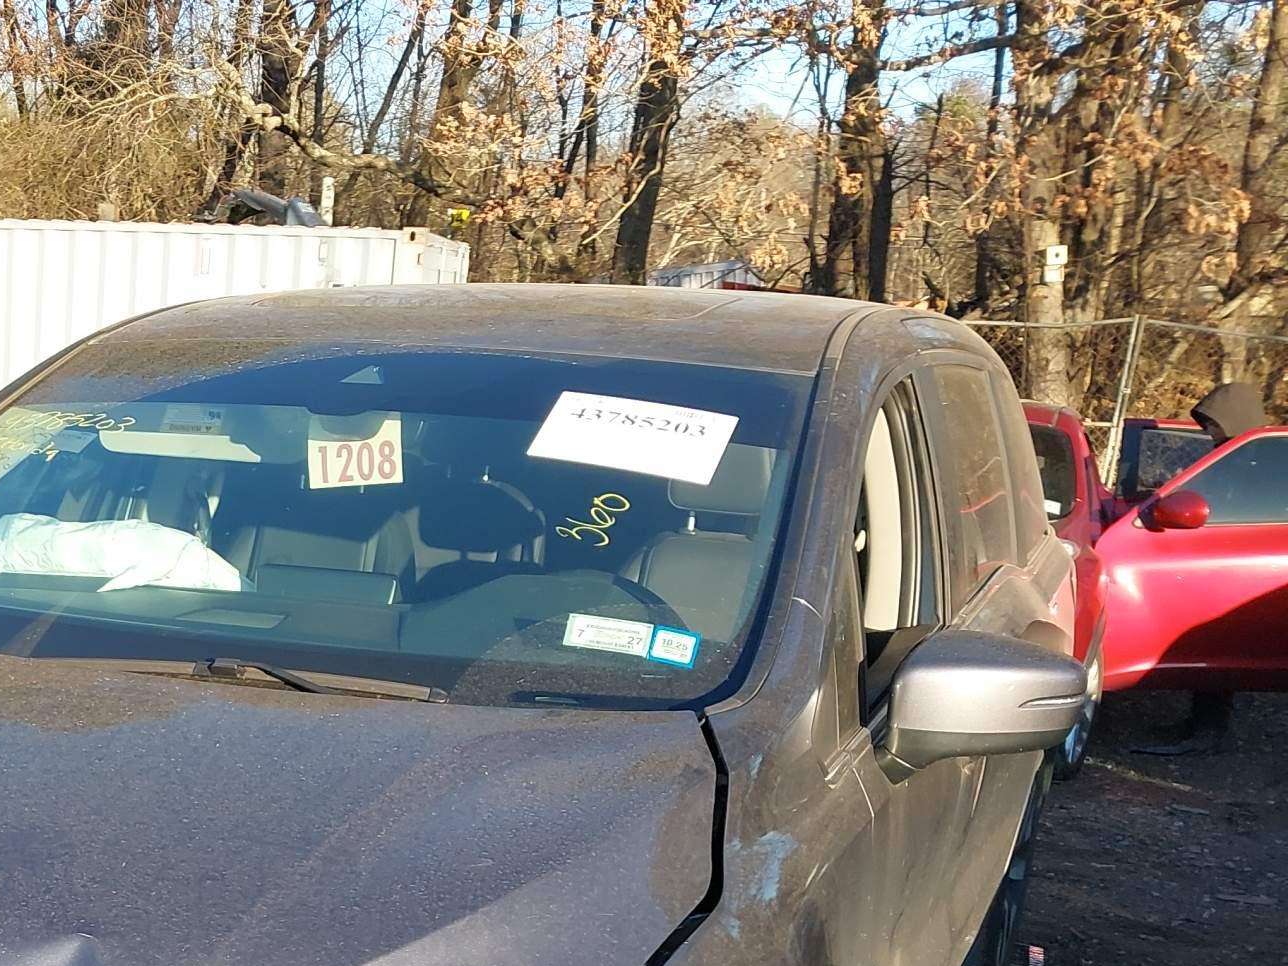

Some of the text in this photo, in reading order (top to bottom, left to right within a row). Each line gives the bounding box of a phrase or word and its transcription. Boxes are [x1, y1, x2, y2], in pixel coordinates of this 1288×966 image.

[571, 407, 707, 437] 43785203
[317, 439, 398, 485] 1208
[555, 491, 631, 548] 360
[626, 635, 644, 647] 27
